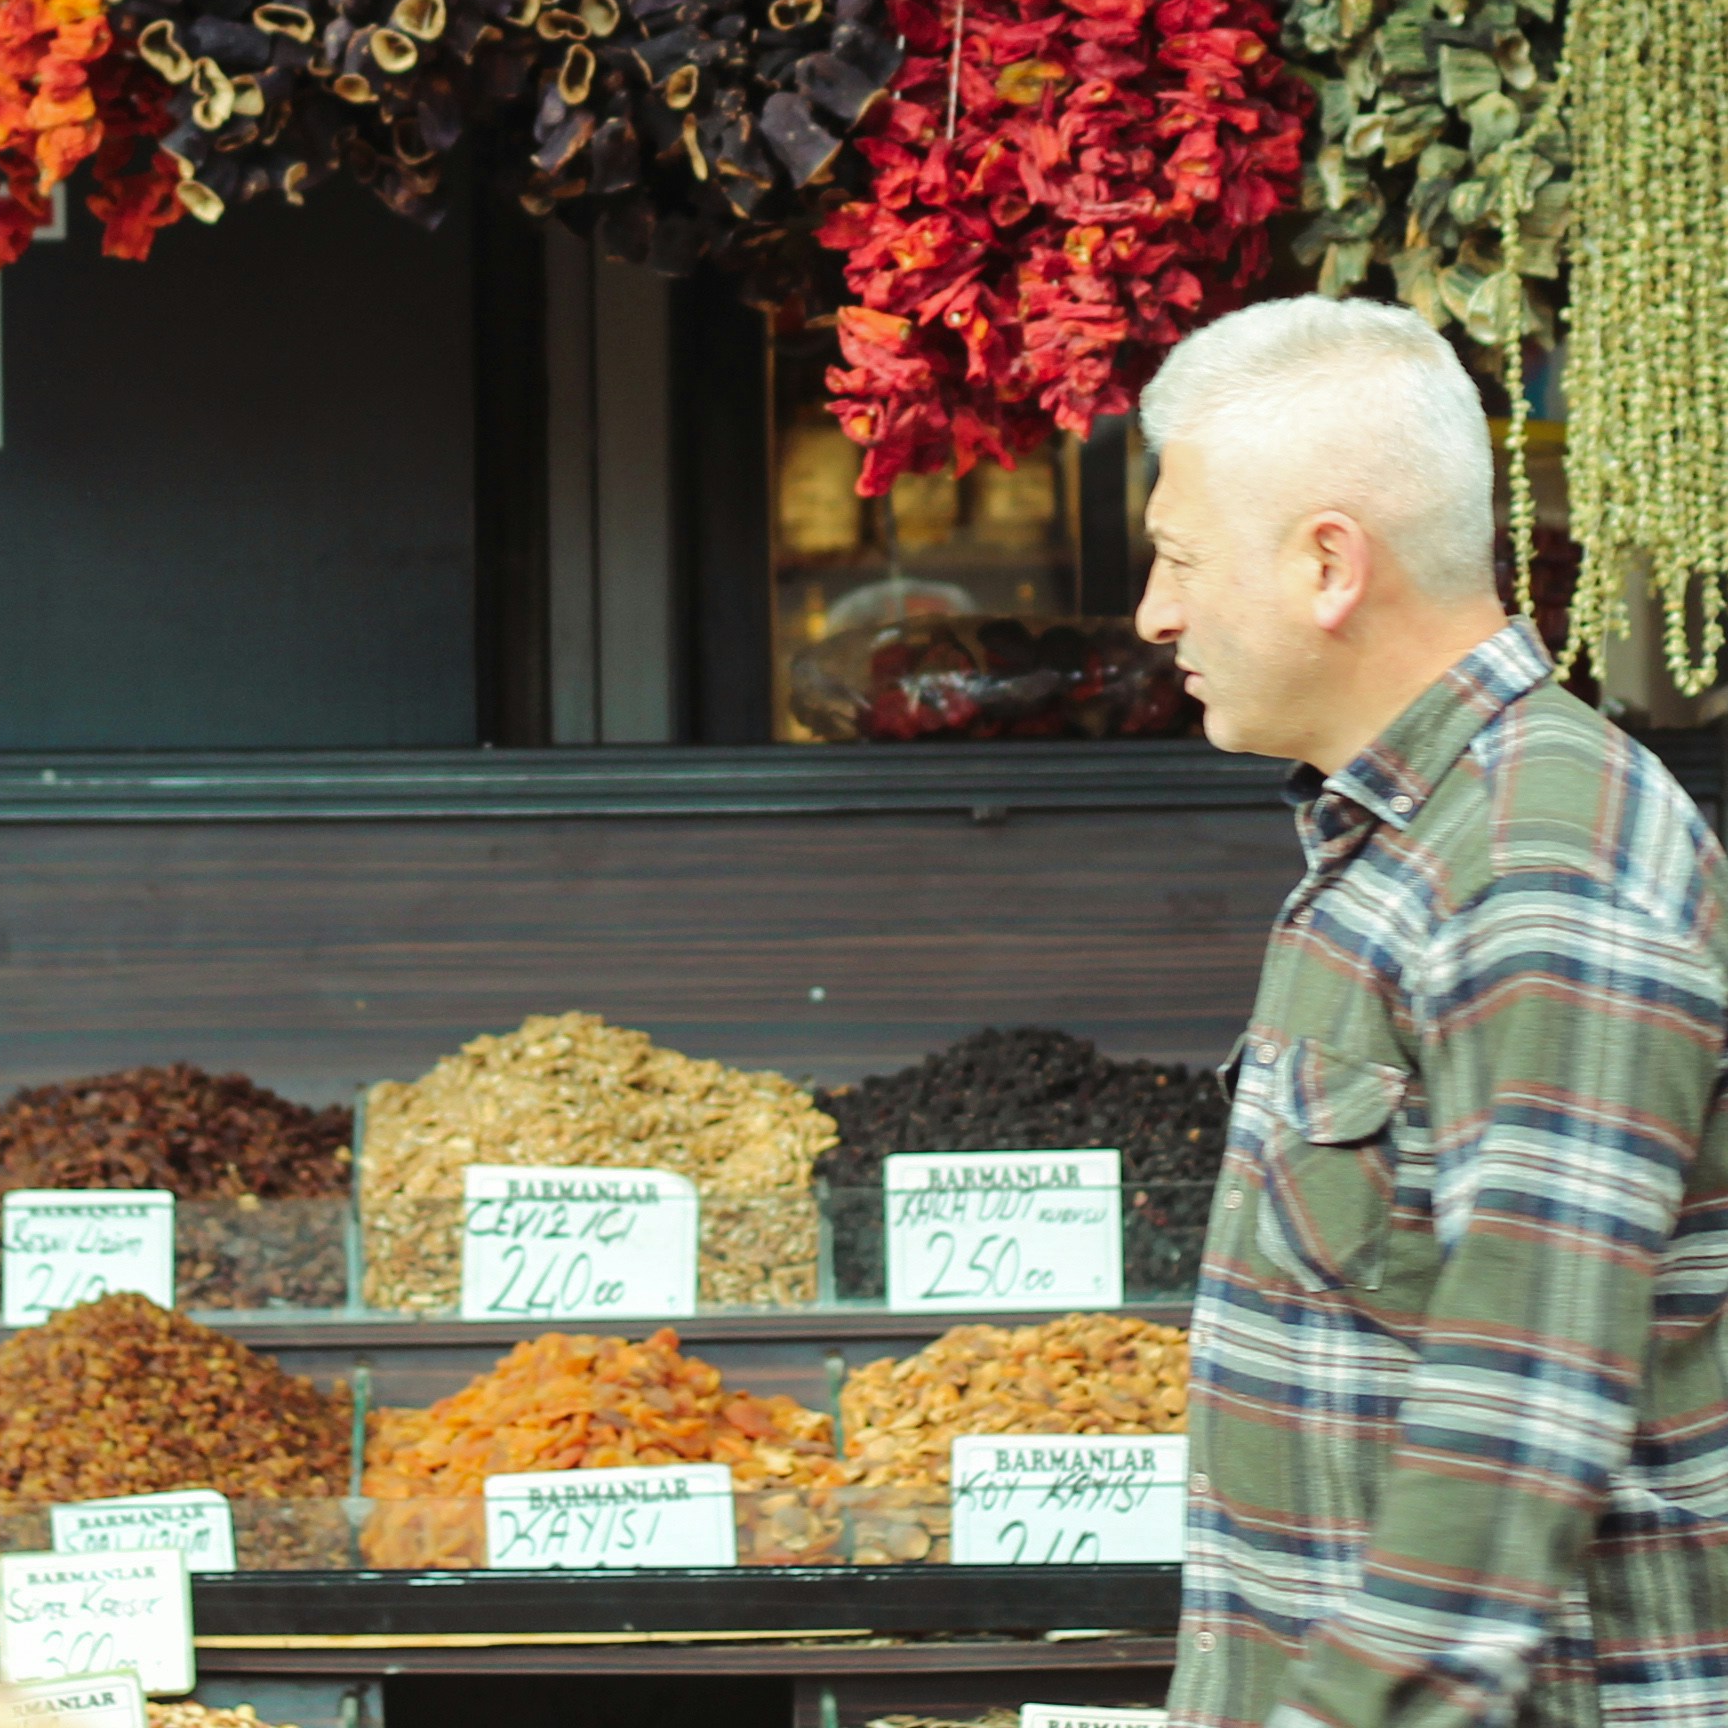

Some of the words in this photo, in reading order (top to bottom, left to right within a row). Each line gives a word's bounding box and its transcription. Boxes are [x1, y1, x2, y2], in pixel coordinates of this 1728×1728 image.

[928, 1163, 1083, 1189] BARMANLAR
[507, 1179, 661, 1204] BARMANLAR
[994, 1448, 1158, 1473] BARMANLAR
[527, 1477, 693, 1511] BARMANLAR
[77, 1505, 207, 1532] BARMANLAR
[495, 1507, 663, 1560] KAYISI
[26, 1565, 157, 1586] BARMANLAR
